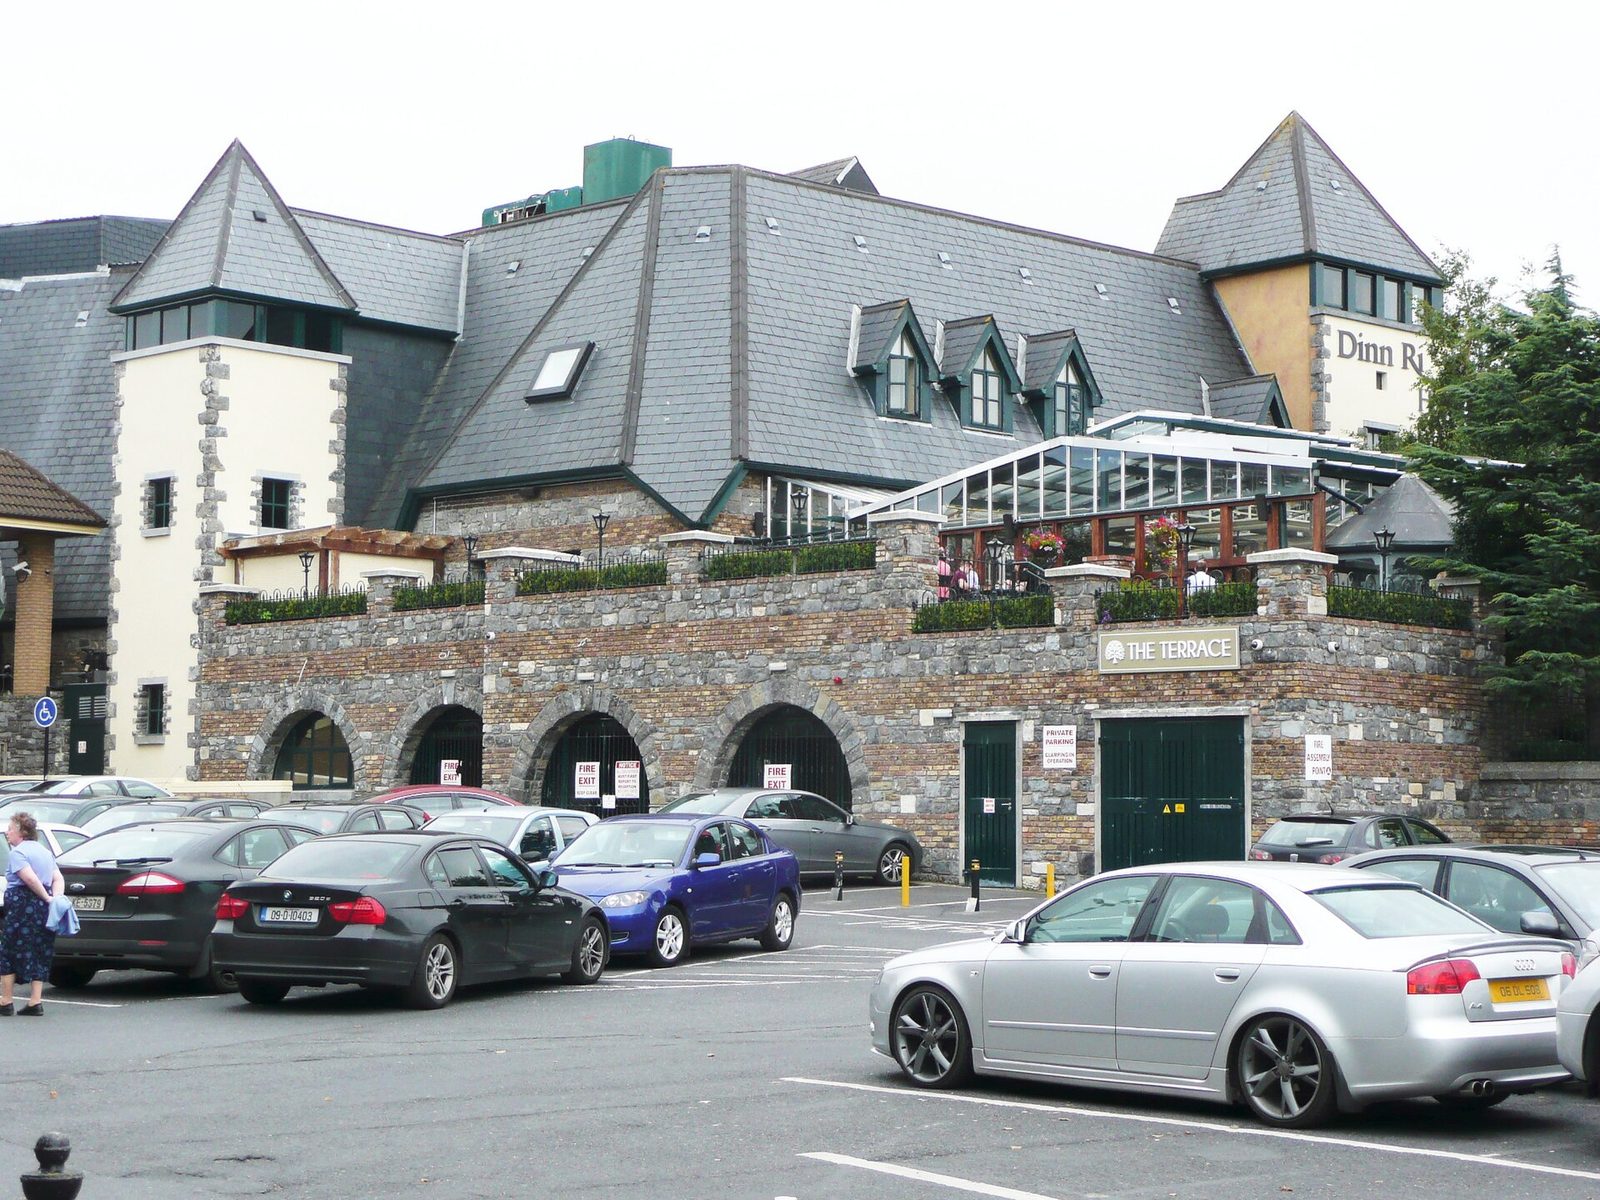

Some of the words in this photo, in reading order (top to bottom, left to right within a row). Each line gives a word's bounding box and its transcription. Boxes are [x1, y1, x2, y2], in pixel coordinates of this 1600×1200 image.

[1337, 329, 1394, 367] Dinn
[1126, 641, 1156, 660] THE
[1159, 638, 1232, 659] TERRACE
[578, 764, 596, 773] FIRE
[767, 767, 787, 776] FIRE
[443, 773, 458, 781] EXIT
[578, 776, 596, 785] EXIT
[767, 780, 787, 788] EXIT
